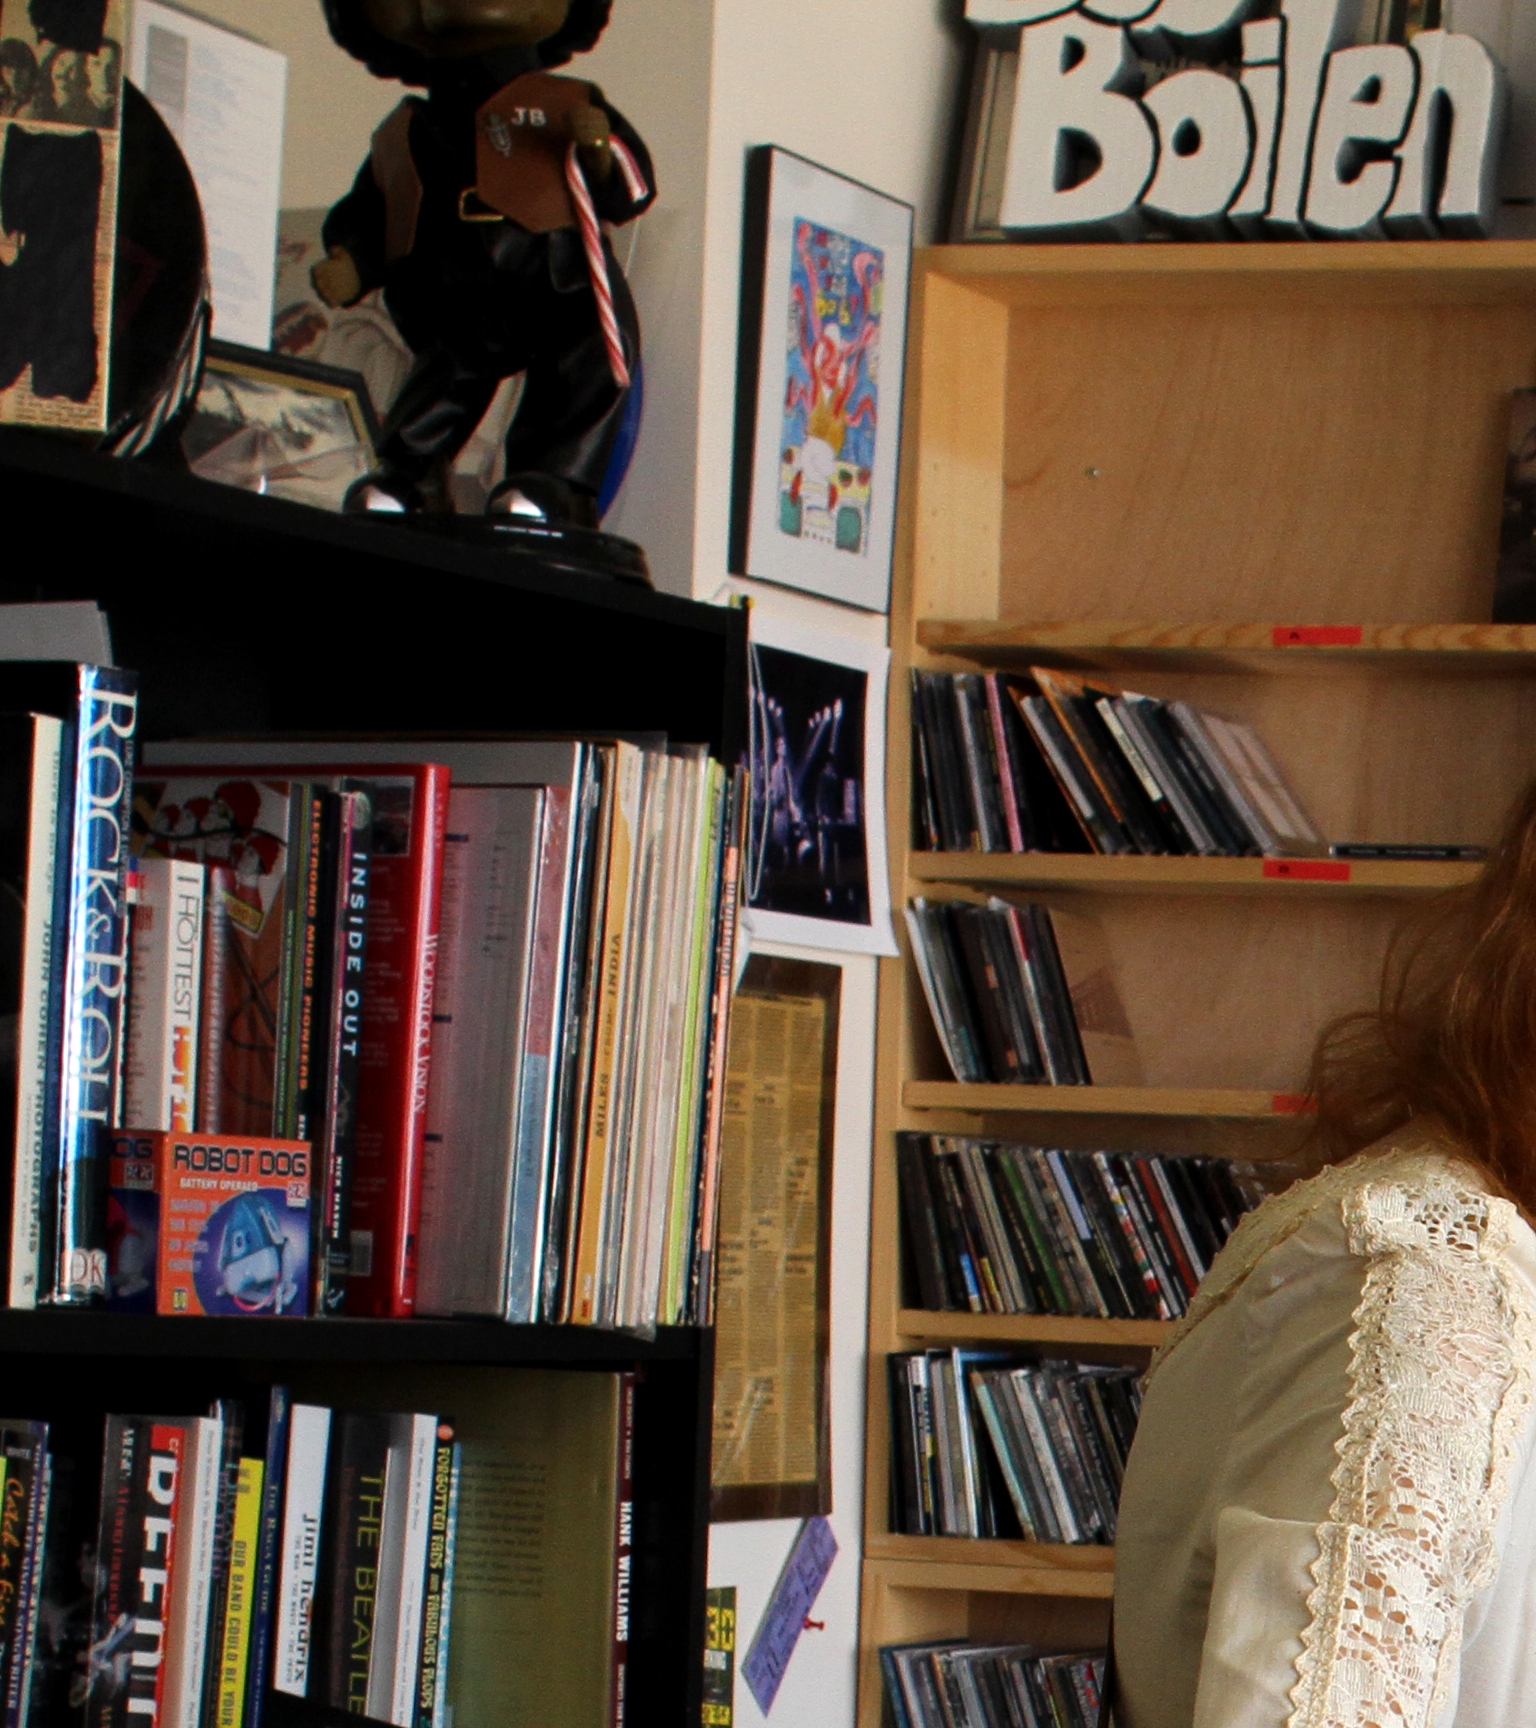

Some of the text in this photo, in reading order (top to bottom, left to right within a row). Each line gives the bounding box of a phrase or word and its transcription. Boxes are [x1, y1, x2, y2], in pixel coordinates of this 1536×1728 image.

[511, 106, 546, 127] JB
[1001, 2, 1494, 230] Boilen
[82, 690, 139, 914] ROCK
[87, 907, 111, 940] &
[299, 800, 321, 1090] ELECTRONIC MUSIC PIONEERS
[342, 852, 370, 1058] INSIDE OUT
[171, 895, 199, 1089] HOTTEST HOT
[418, 933, 438, 1051] WOODSTOCK
[173, 1144, 307, 1177] ROBOT DOG
[430, 1447, 452, 1531] FORGOTTEN
[233, 1540, 247, 1570] OUR
[302, 1514, 319, 1567] jimi
[428, 1534, 446, 1569] FADS
[615, 1501, 633, 1642] HANK WILLIAMS
[229, 1573, 245, 1612] BAND
[349, 1469, 385, 1715] THE BEATLE
[225, 1617, 241, 1664] COULD
[422, 1594, 440, 1665] FABULOUS
[223, 1667, 238, 1685] BE
